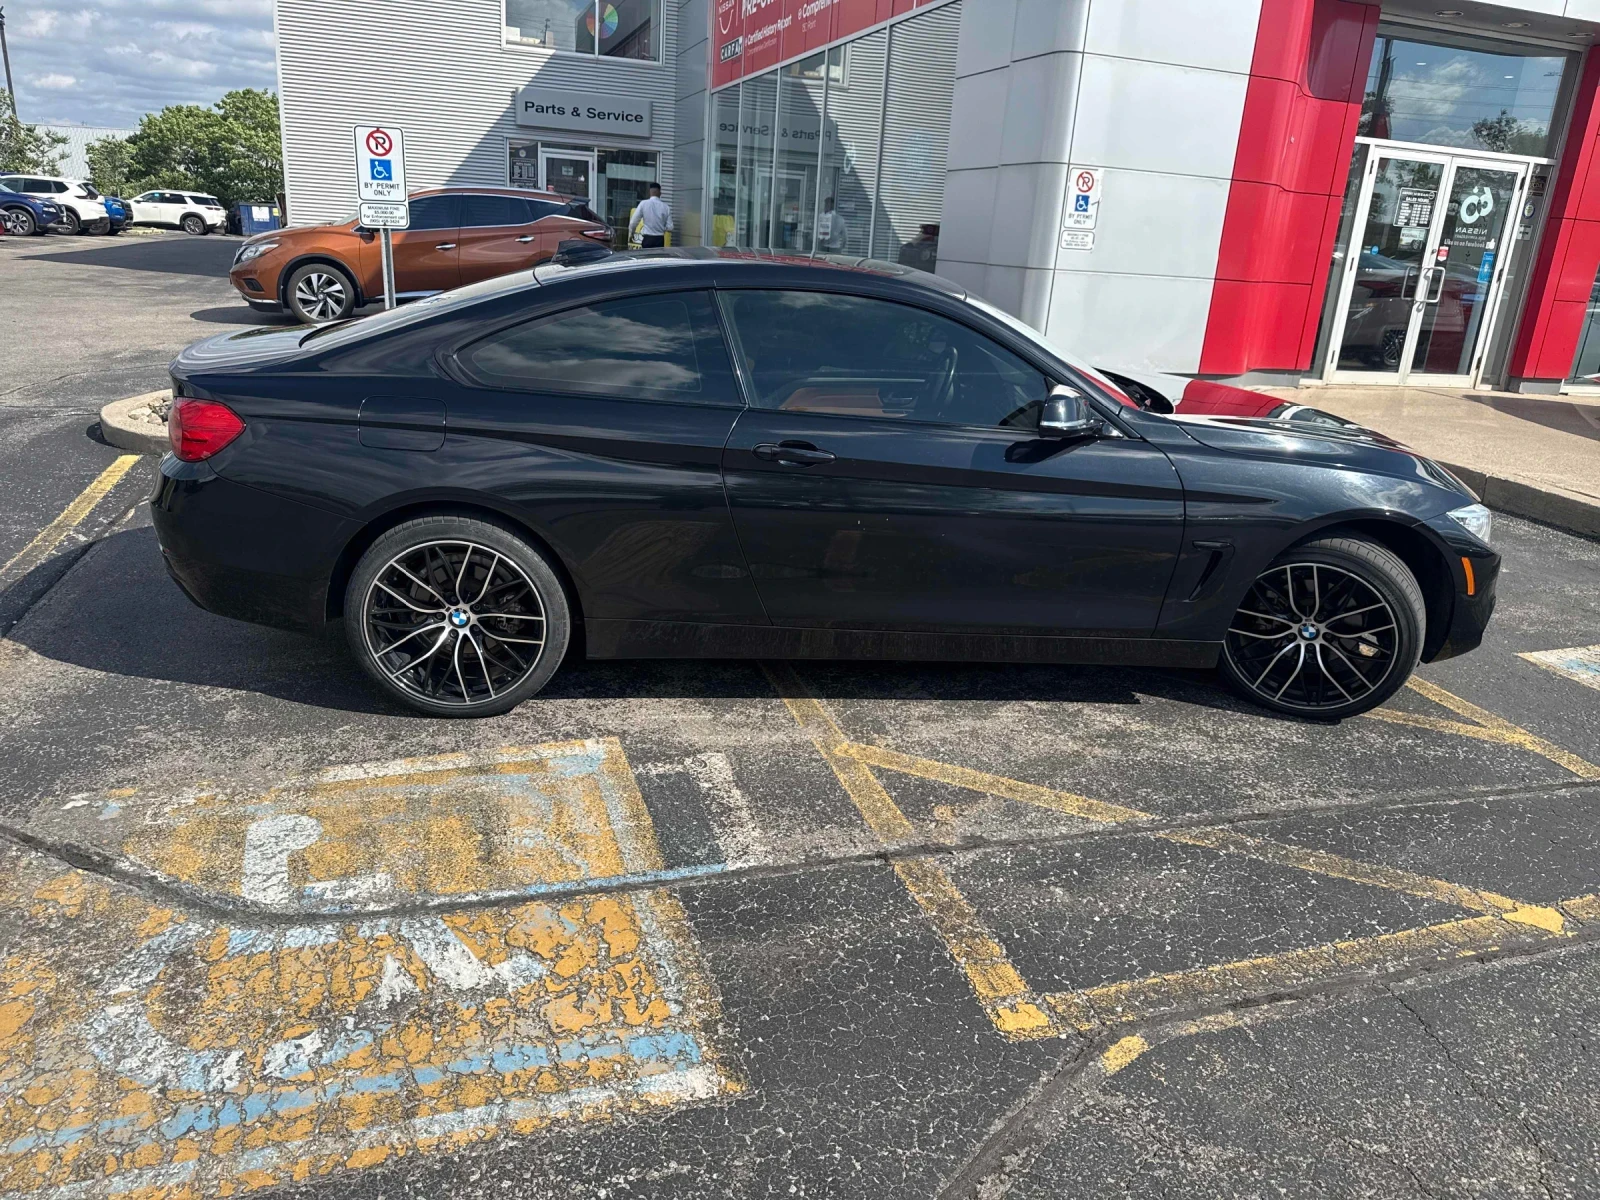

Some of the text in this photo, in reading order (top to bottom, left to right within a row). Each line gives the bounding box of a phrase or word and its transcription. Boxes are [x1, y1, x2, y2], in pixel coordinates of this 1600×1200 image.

[524, 101, 644, 122] Parts & Service
